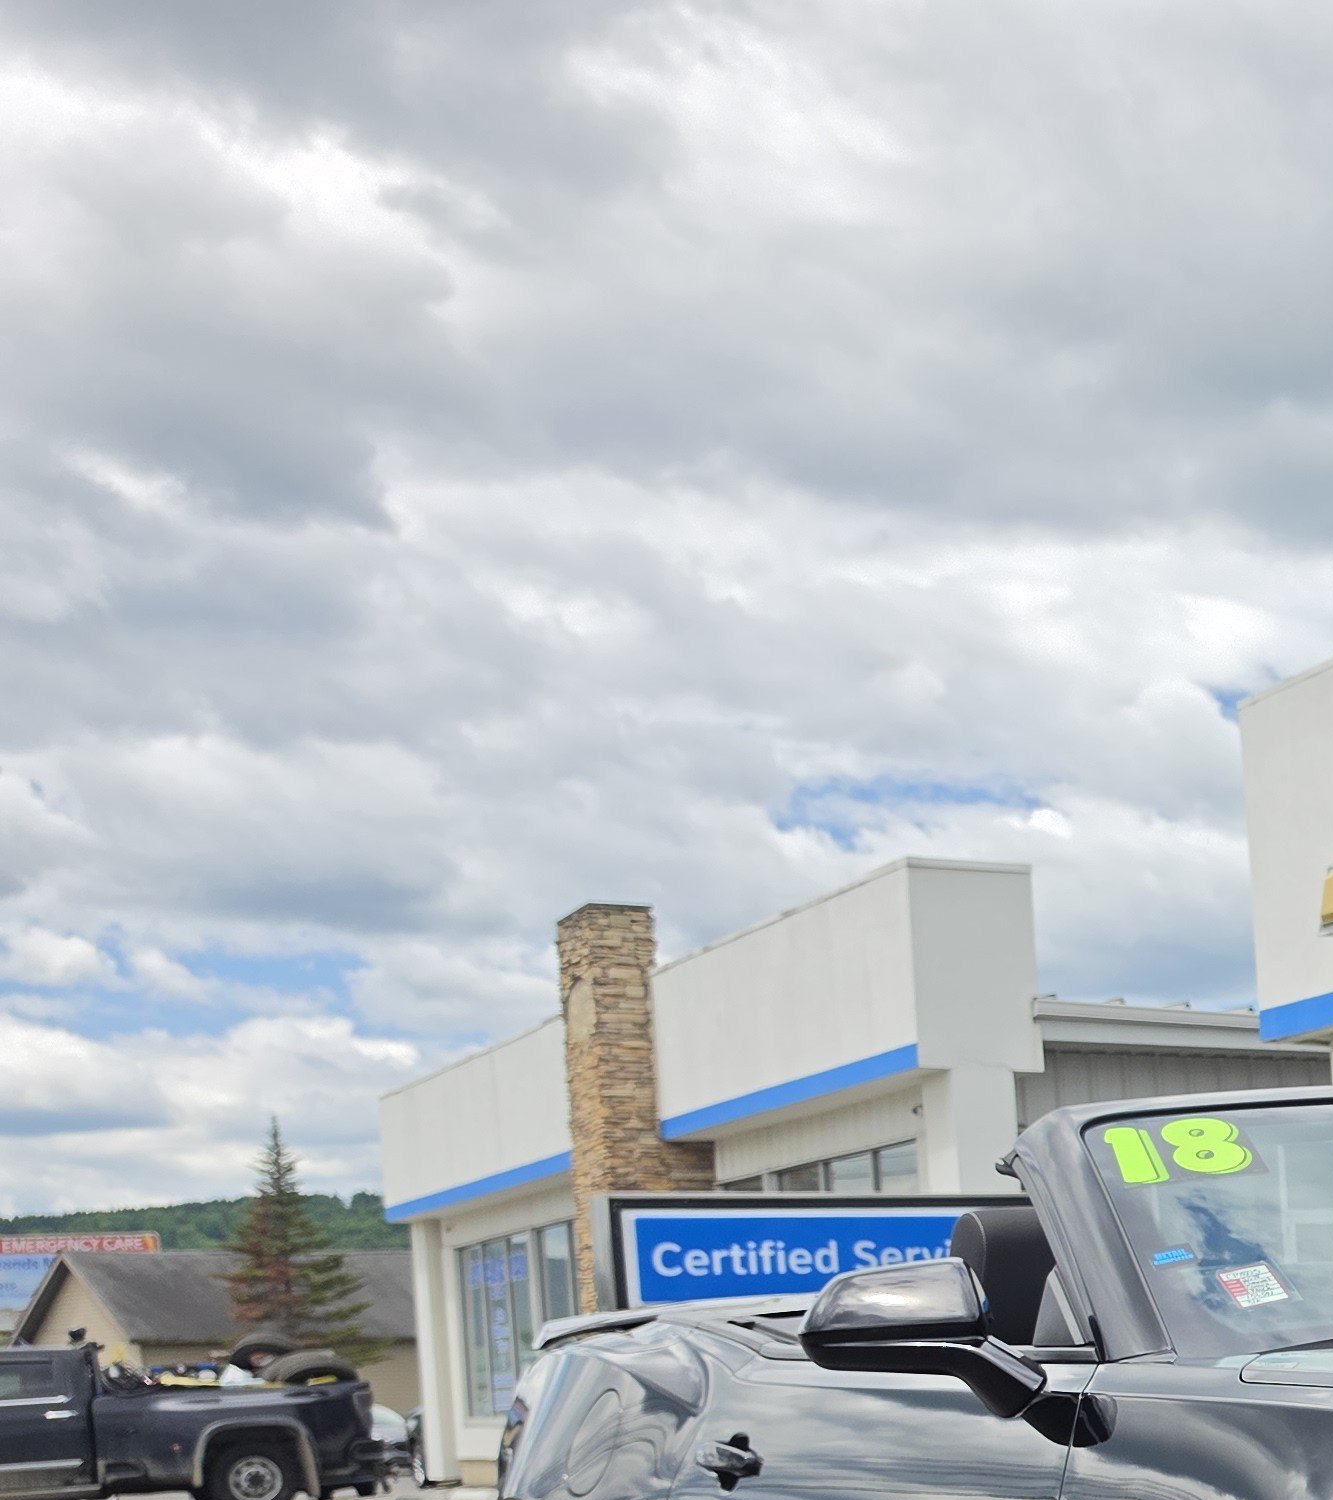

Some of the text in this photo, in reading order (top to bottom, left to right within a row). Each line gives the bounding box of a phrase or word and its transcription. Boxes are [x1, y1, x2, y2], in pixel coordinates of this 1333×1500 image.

[1104, 1117, 1253, 1184] 18
[2, 1237, 144, 1252] EMERGENCY CARE
[652, 1239, 839, 1277] Certified
